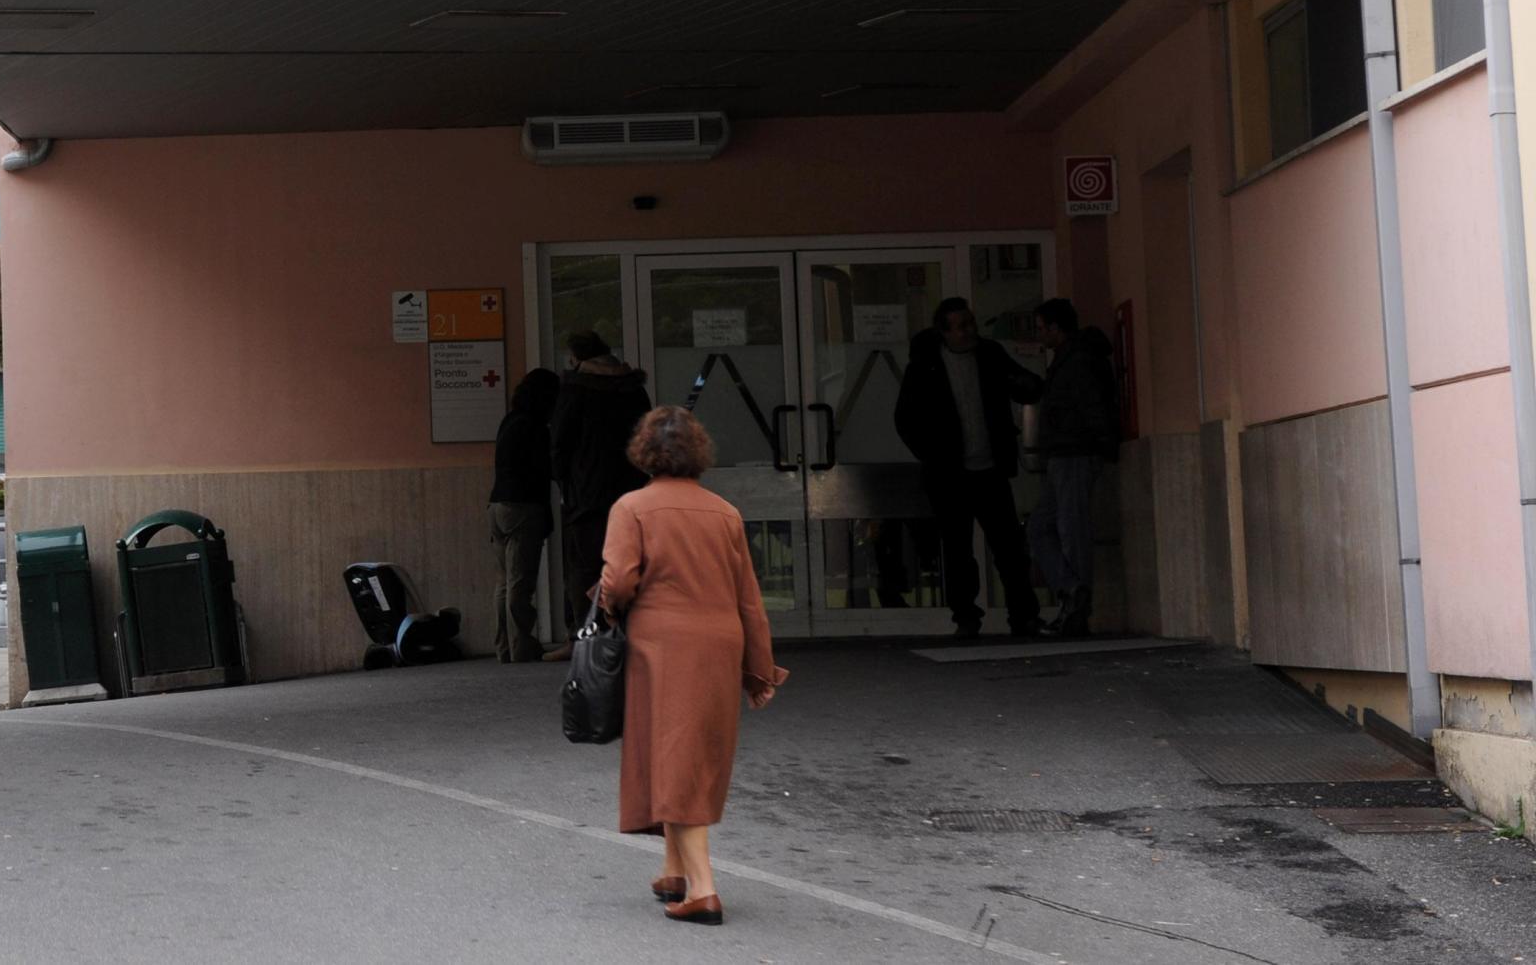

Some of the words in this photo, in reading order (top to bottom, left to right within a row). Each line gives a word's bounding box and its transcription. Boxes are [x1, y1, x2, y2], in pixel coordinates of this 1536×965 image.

[1070, 202, 1113, 212] IDRANTE
[434, 314, 457, 336] 21
[434, 369, 468, 378] Pronto
[434, 380, 482, 389] Soccorso
